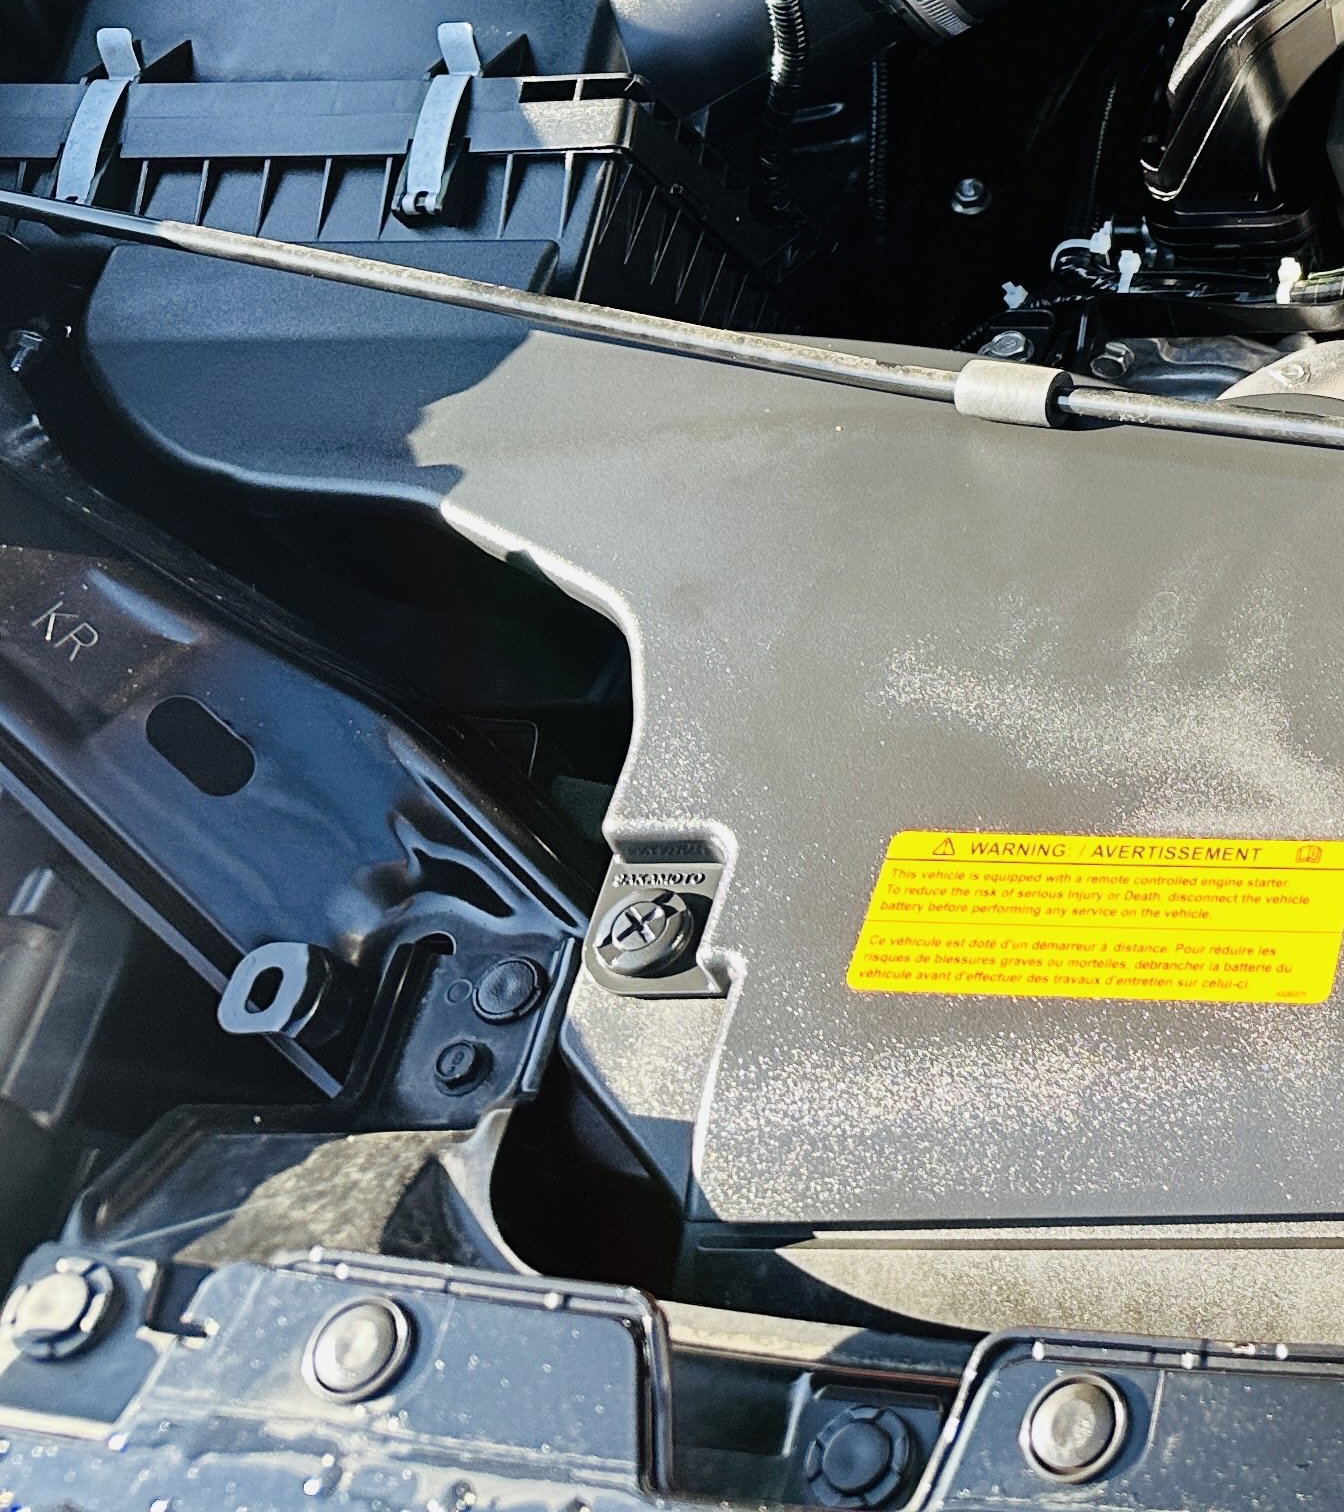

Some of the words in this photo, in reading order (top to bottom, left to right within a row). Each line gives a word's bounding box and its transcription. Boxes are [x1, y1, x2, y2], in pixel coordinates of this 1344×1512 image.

[31, 601, 100, 663] KR
[970, 842, 1067, 858] WARNING
[1091, 844, 1264, 862] AVERTISSEMENT
[891, 868, 917, 880] This
[921, 870, 966, 881] vehicle
[968, 871, 979, 881] is
[983, 872, 1042, 885] equipped
[1045, 873, 1071, 884] with
[1074, 876, 1082, 884] a
[1085, 875, 1130, 886] remote
[1133, 876, 1197, 887] controlled
[1200, 878, 1243, 889] engine
[1246, 878, 1290, 889] starter.
[886, 884, 901, 895] To
[903, 885, 947, 897] reduce
[950, 887, 970, 897] the
[974, 887, 997, 898] risk
[1000, 888, 1016, 898] of
[1016, 889, 1063, 900] serious
[1067, 889, 1104, 902] Injury
[1107, 892, 1122, 902] or
[1167, 892, 1239, 904] disconnect
[1241, 893, 1262, 904] the
[1265, 895, 1311, 906] vehicle
[879, 900, 924, 914] battery
[927, 901, 969, 914] before
[971, 903, 1041, 917] performing
[1044, 905, 1068, 917] any
[1071, 905, 1117, 918] service
[1120, 908, 1137, 918] on
[1140, 907, 1161, 918] the
[1164, 908, 1213, 920] vehicle.
[868, 934, 886, 946] Ce
[889, 935, 943, 948] véhicule
[945, 938, 967, 949] est
[968, 938, 997, 950] doté
[1000, 939, 1028, 950] d'un
[1031, 940, 1097, 952] démarreur
[1099, 941, 1108, 952] à
[1174, 943, 1206, 955] Pour
[1209, 944, 1254, 956] réduire
[1257, 946, 1277, 957] les
[863, 952, 911, 964] risques
[914, 952, 931, 964] de
[933, 954, 996, 966] blessures
[999, 955, 1043, 969] graves
[1047, 957, 1063, 968] ou
[1133, 958, 1205, 972] débrancher
[1209, 960, 1220, 972] la
[1223, 961, 1273, 973] batterie
[1275, 962, 1293, 974] du
[858, 967, 913, 980] véhicule
[915, 970, 952, 981] avant
[954, 969, 1023, 983] d'effectuer
[1026, 972, 1049, 984] des
[1053, 972, 1100, 985] travaux
[1104, 974, 1173, 988] d'entretien
[1176, 978, 1200, 989] sur
